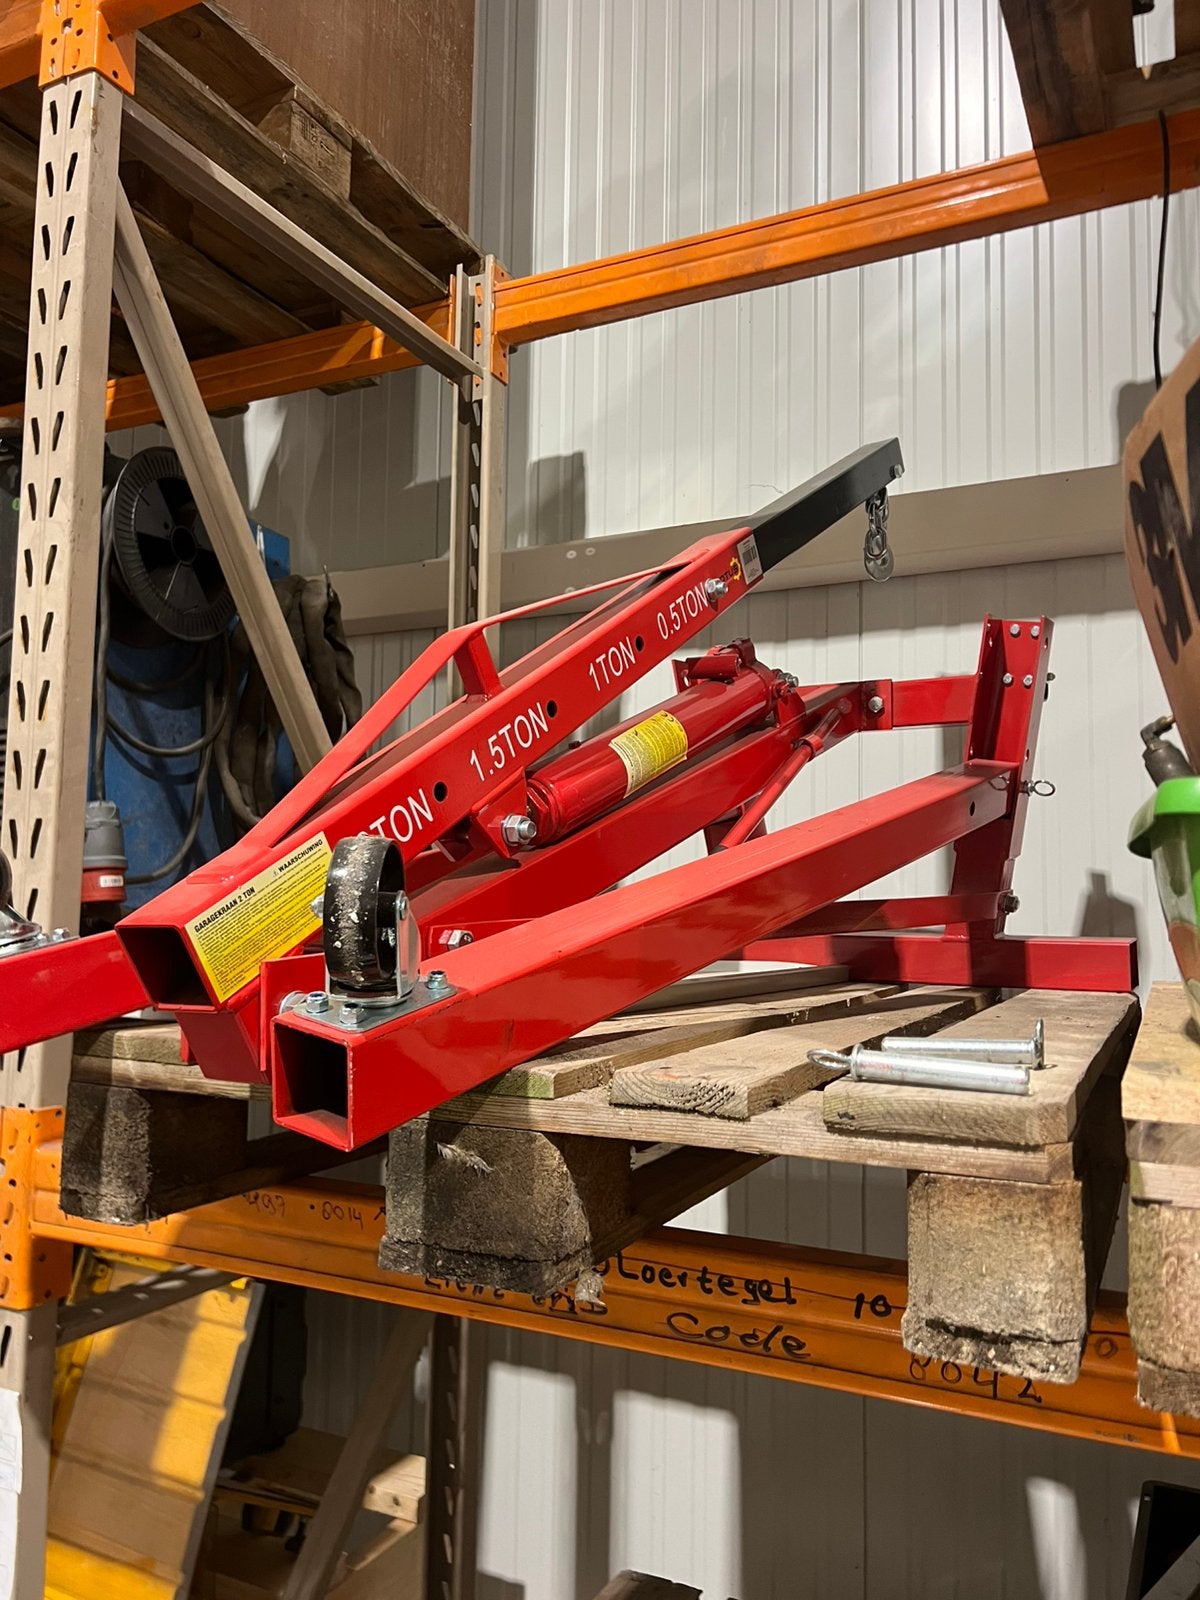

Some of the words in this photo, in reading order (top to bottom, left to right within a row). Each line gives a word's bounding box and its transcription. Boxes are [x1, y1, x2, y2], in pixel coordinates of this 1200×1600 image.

[656, 582, 709, 640] 0.5TON
[588, 635, 636, 692] 1TON
[469, 701, 551, 782] 1.5TON
[356, 787, 434, 843] TON
[277, 839, 323, 872] WAARSCHUWING
[194, 898, 239, 933] GARAGEKRAAN
[237, 895, 244, 903] 2
[242, 886, 256, 899] TON
[854, 1292, 893, 1319] 10
[665, 1311, 811, 1359] Code
